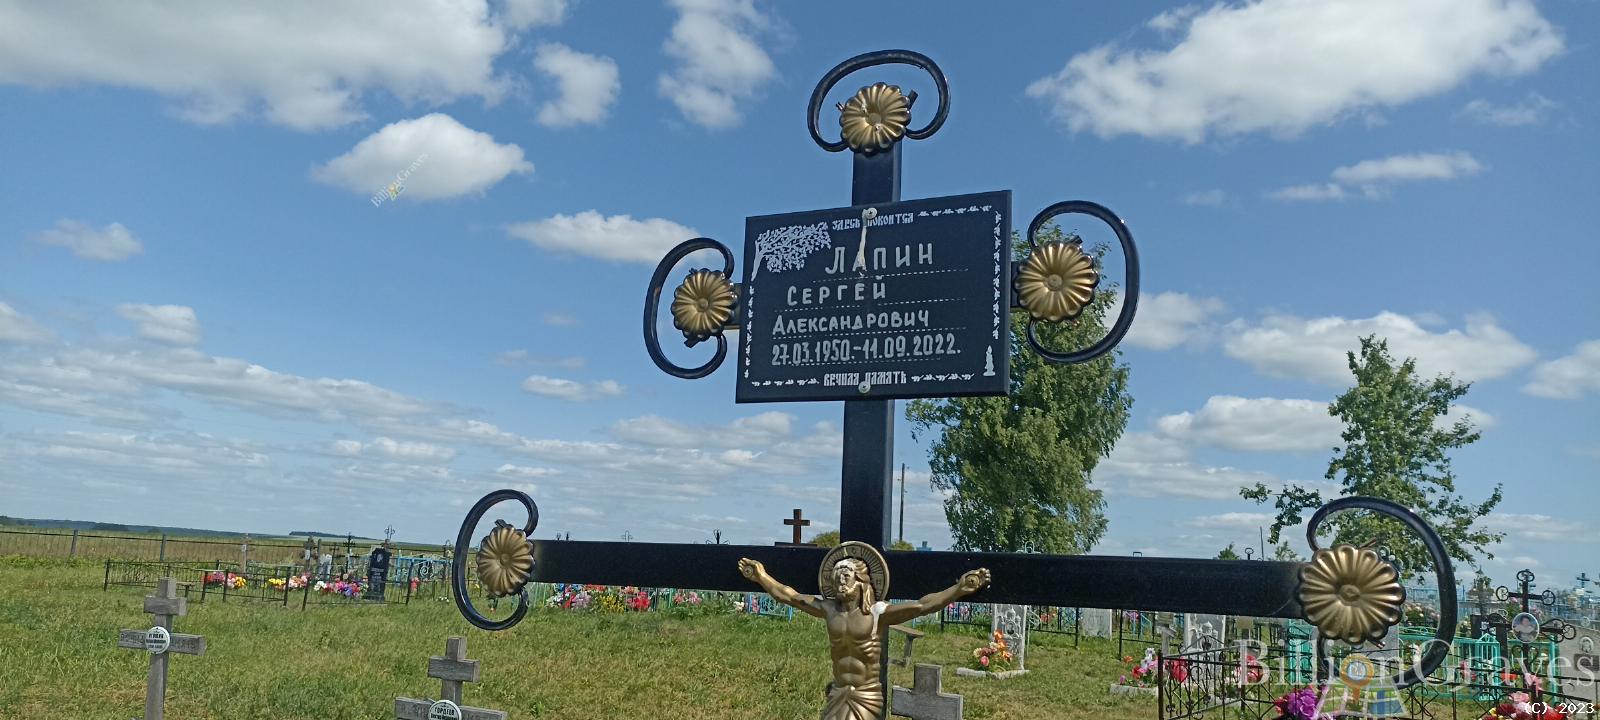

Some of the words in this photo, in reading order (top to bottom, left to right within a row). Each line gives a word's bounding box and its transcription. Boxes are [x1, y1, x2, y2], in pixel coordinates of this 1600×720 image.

[824, 242, 933, 275] ЛАПИН
[786, 275, 886, 306] СЕРГЕЙ
[772, 309, 930, 336] АЛЕКСАНДРОВИЧ
[823, 372, 860, 387] ВЕЧНАЯ
